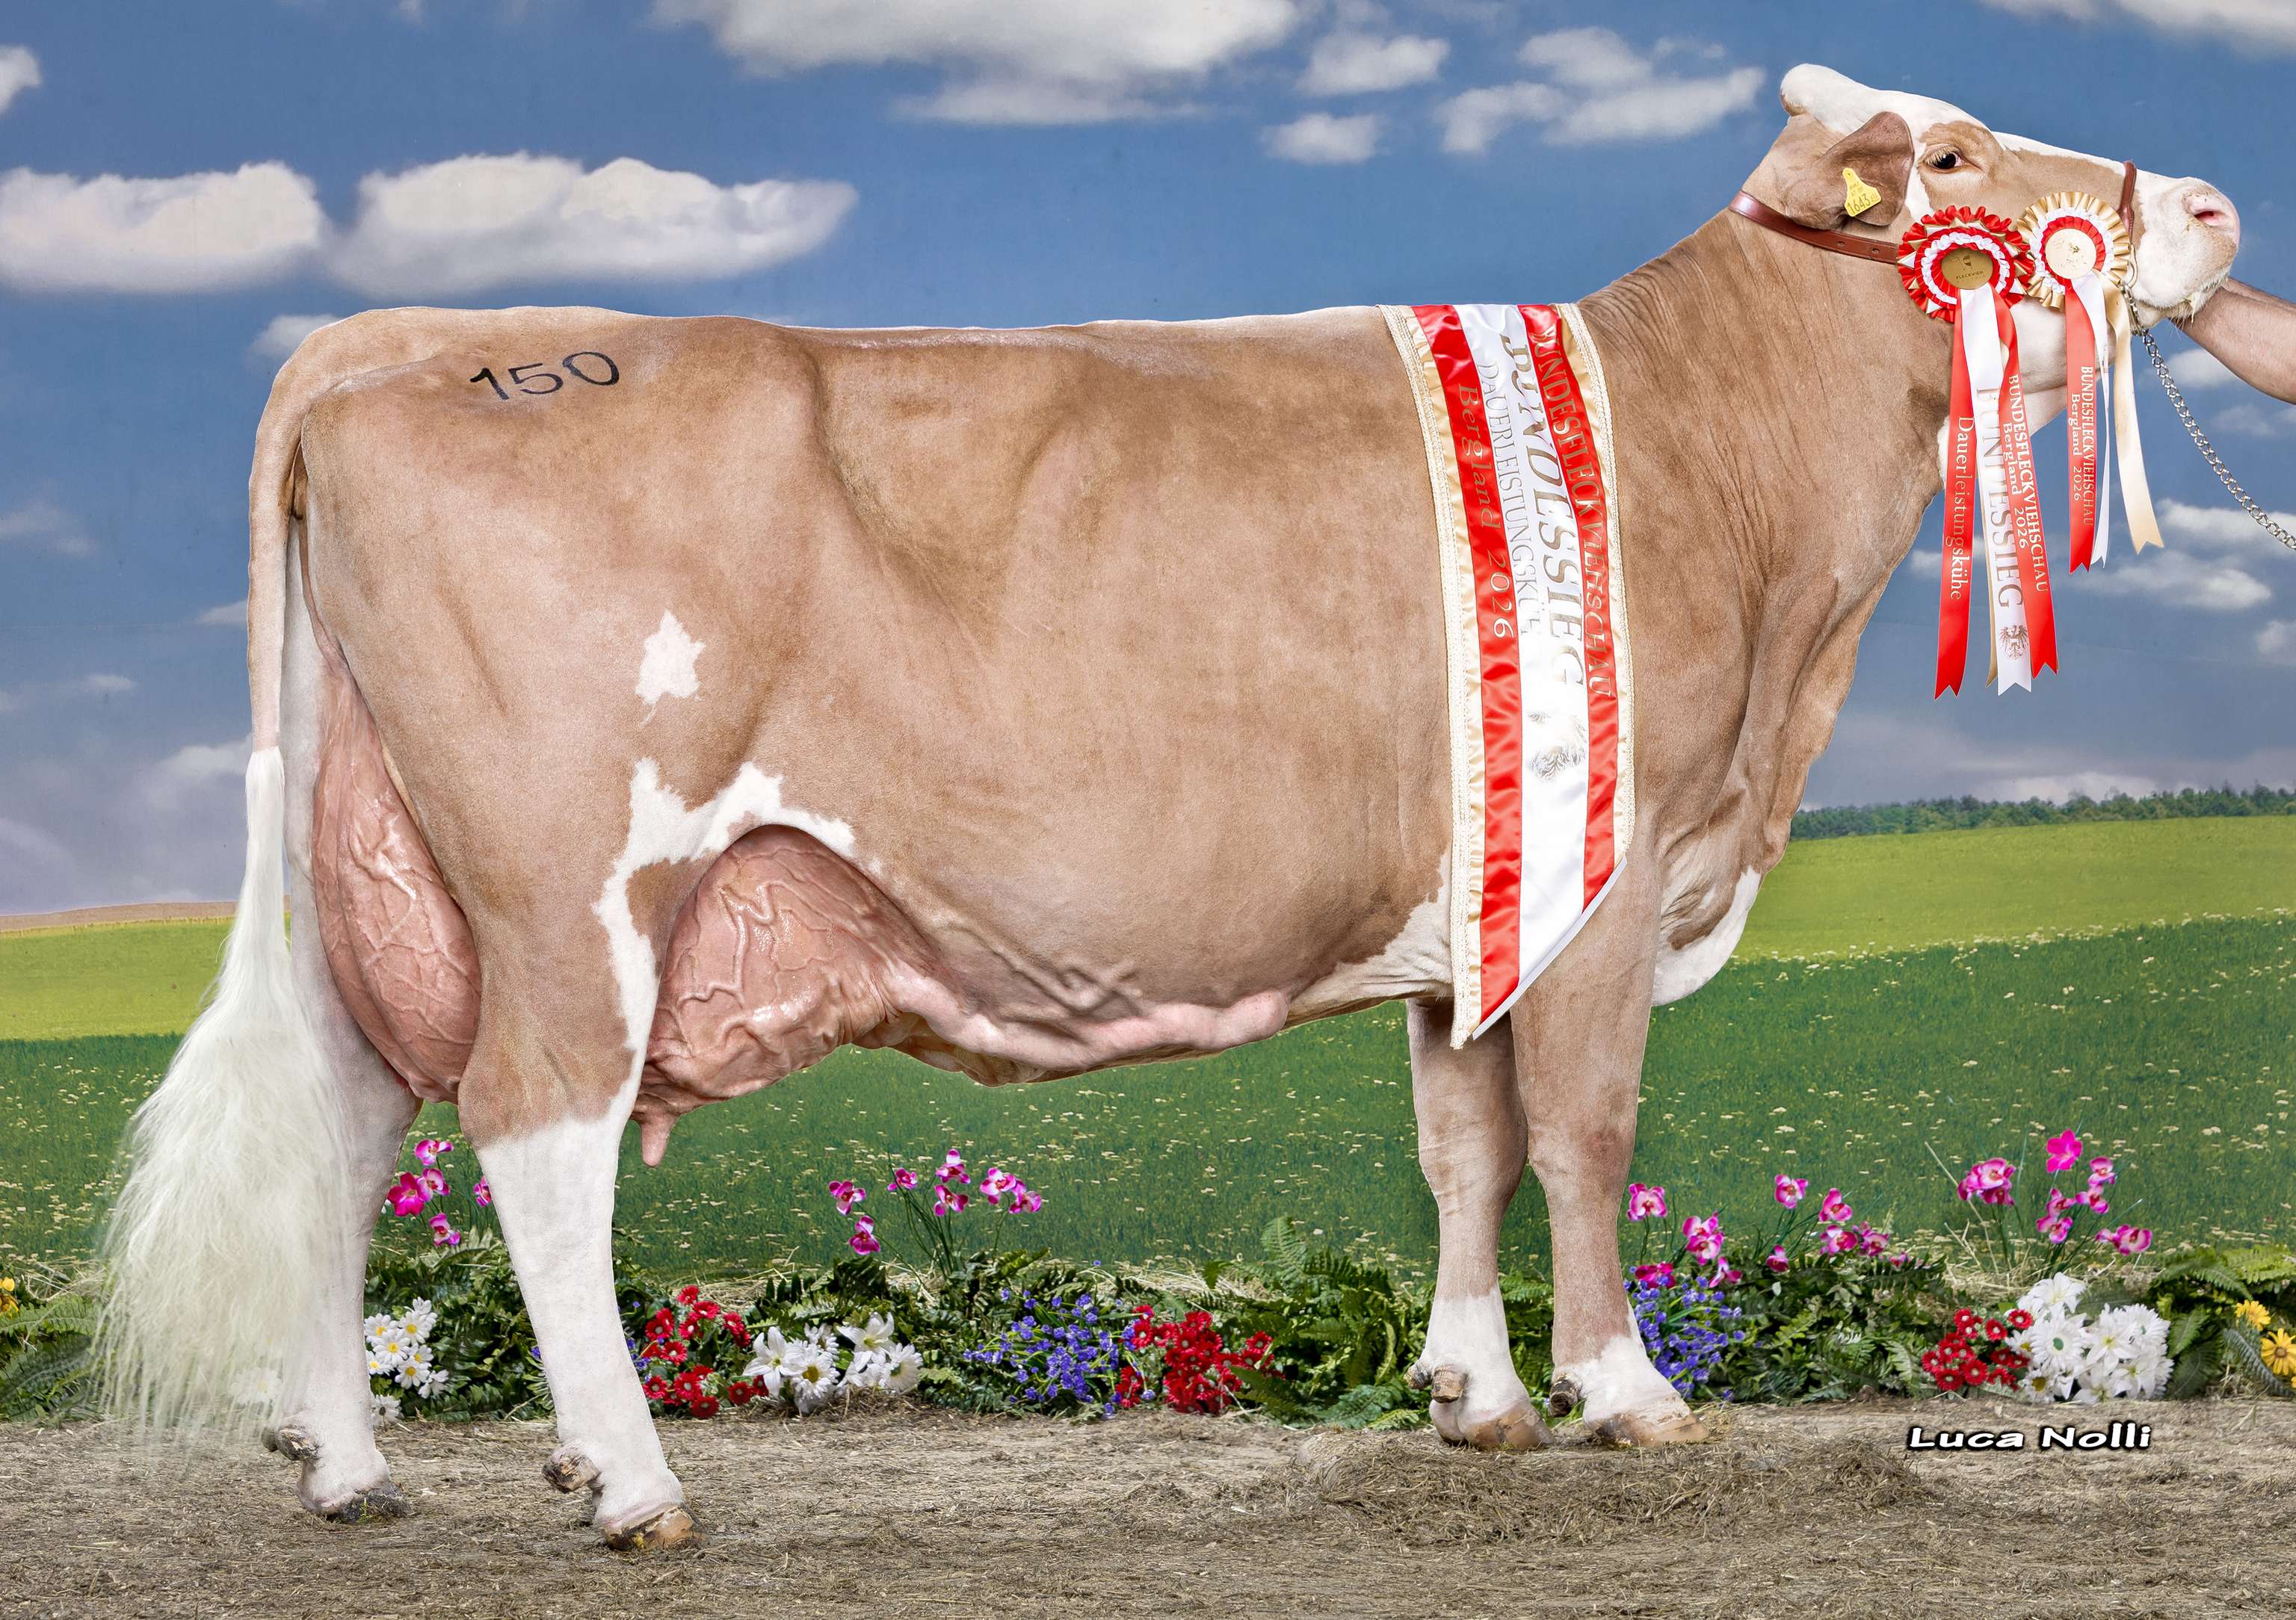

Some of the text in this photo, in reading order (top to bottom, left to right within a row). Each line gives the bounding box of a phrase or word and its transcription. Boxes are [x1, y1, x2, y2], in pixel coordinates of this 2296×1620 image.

[1847, 193, 1871, 214] 1643
[469, 351, 620, 401] 150
[2068, 393, 2083, 501] Bergland 2026
[2081, 365, 2094, 527] BUNDESFLECKVIEHSCHAU
[1457, 383, 1516, 640] Bergland 2026
[1945, 416, 1975, 601] Dauerleistungskühe
[2002, 421, 2030, 549] Bergland 2026
[2008, 374, 2049, 593] BUNDESFLECKVIEHSCHAU
